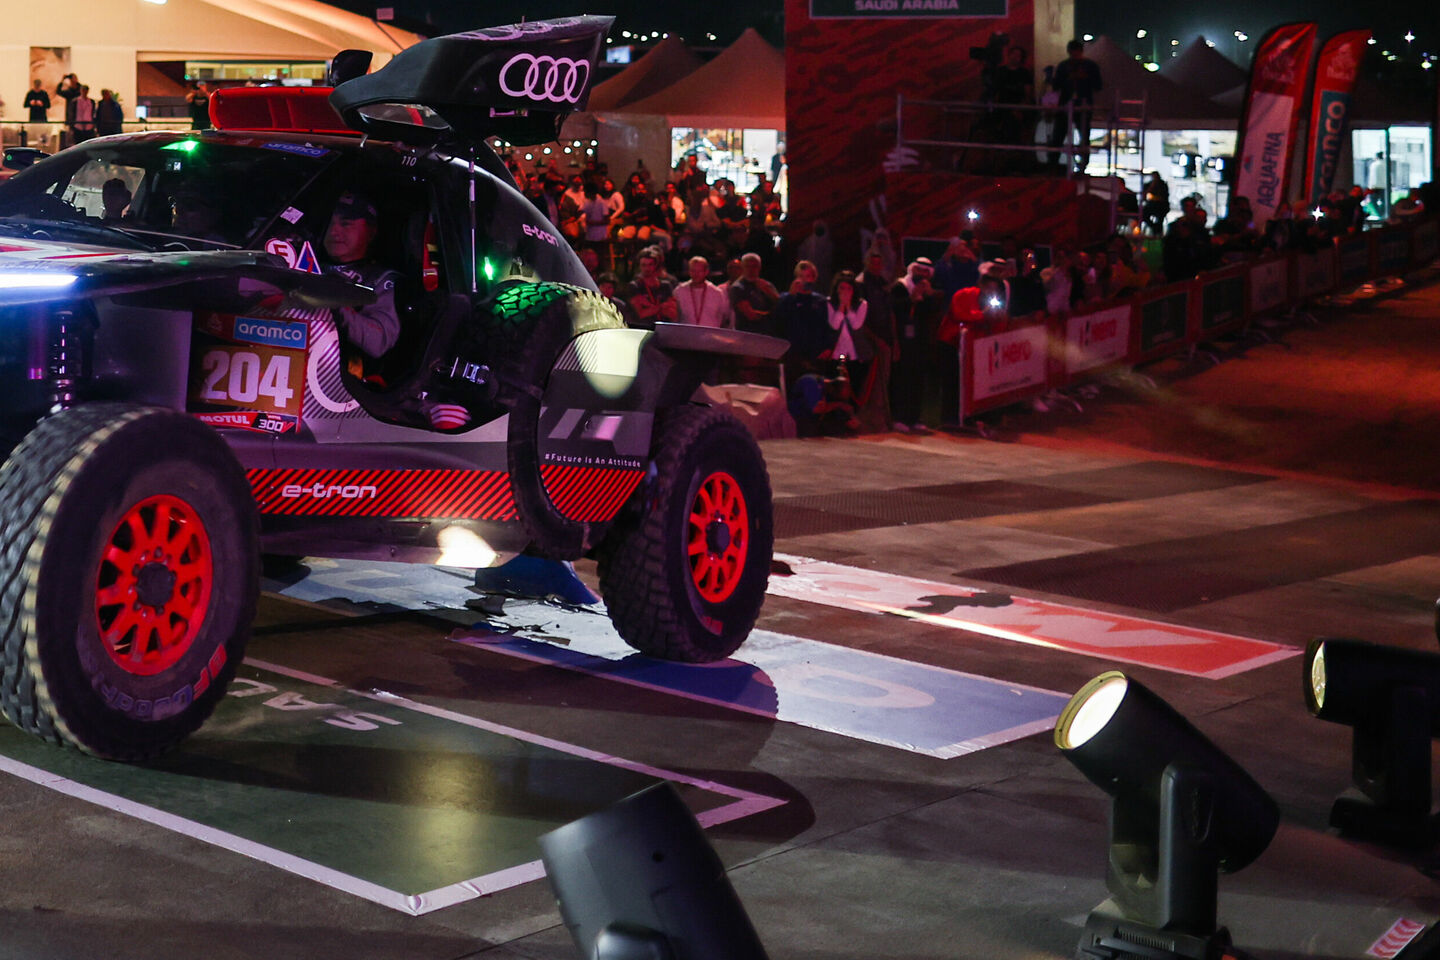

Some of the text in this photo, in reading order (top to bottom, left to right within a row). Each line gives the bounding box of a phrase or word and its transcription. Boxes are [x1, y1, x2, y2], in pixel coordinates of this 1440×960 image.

[1257, 131, 1285, 208] AQUAFINA
[522, 223, 559, 248] e-tron
[238, 323, 302, 341] aramco
[200, 350, 294, 409] 204
[199, 414, 250, 425] MOTUL
[258, 419, 295, 432] 300V
[545, 453, 582, 464] #Future
[608, 458, 641, 468] Attitude
[282, 483, 377, 498] e-tron
